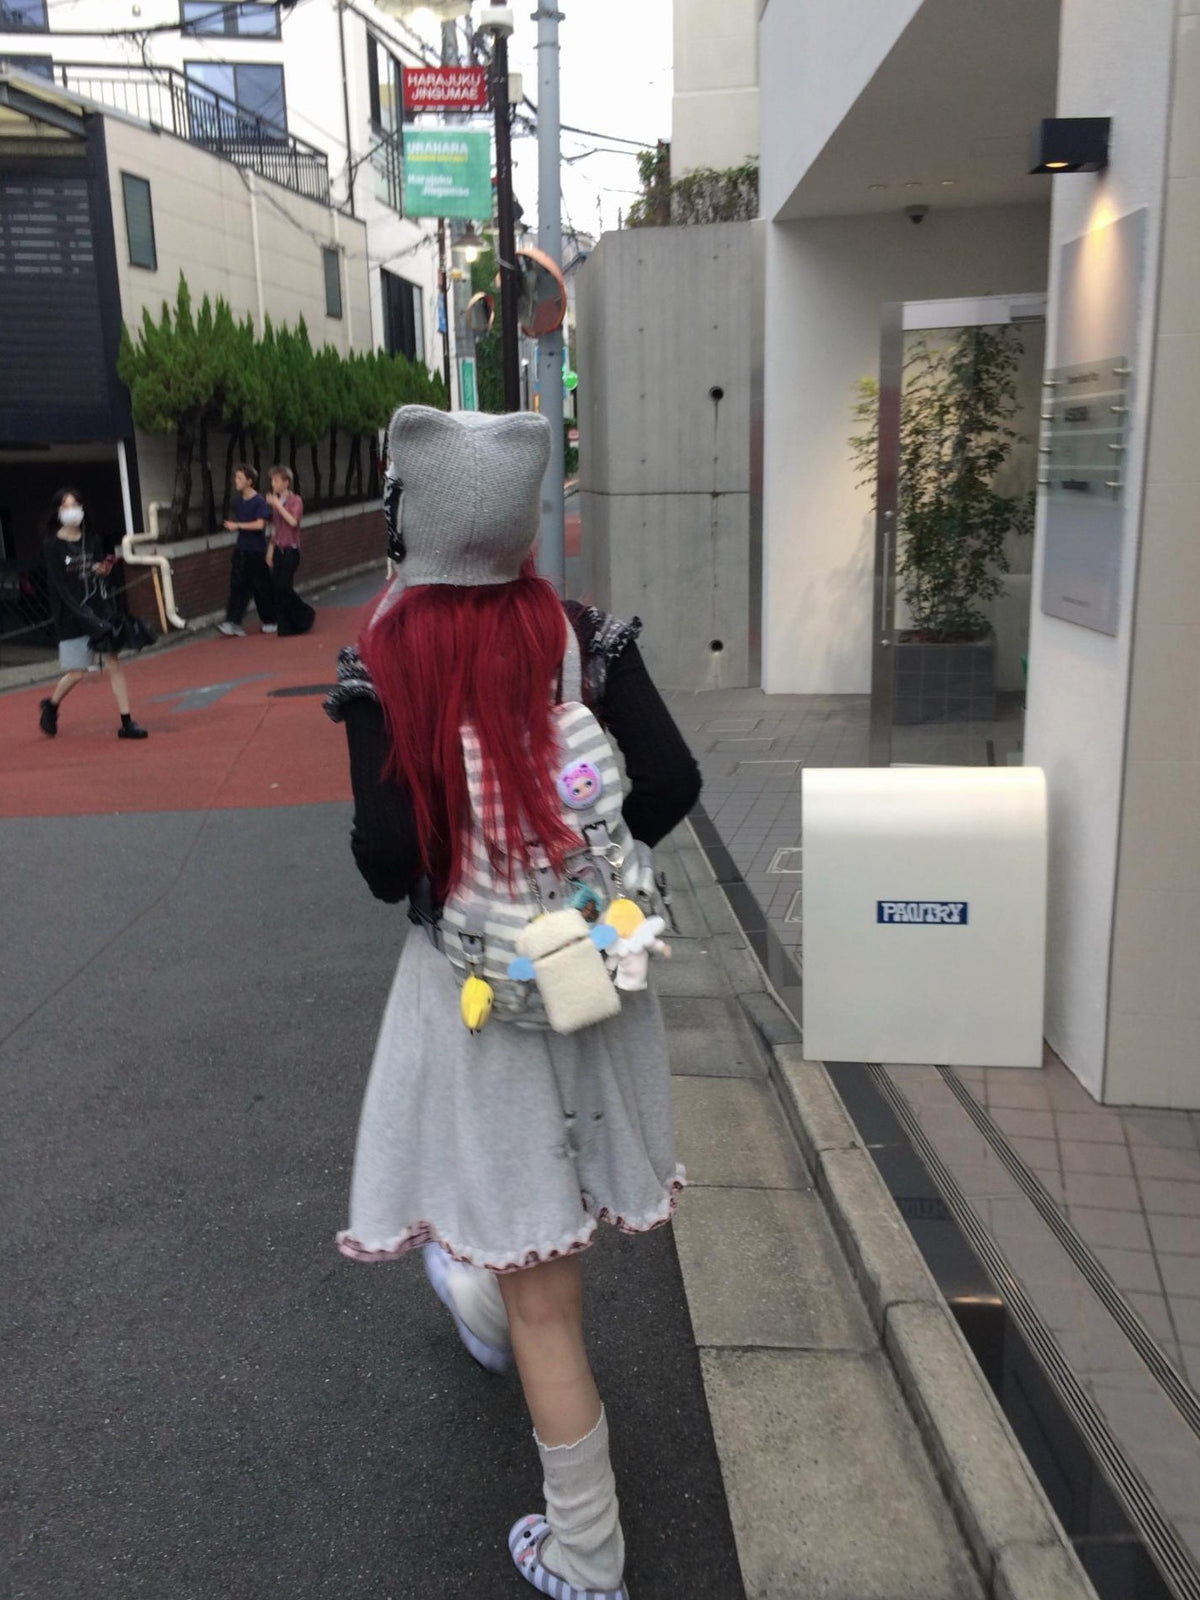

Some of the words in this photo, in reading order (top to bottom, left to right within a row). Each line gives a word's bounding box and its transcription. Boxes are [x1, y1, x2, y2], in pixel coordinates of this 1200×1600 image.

[407, 73, 481, 88] HARAJUKU
[411, 87, 479, 101] JINGUMAE
[406, 141, 469, 154] URAHARA
